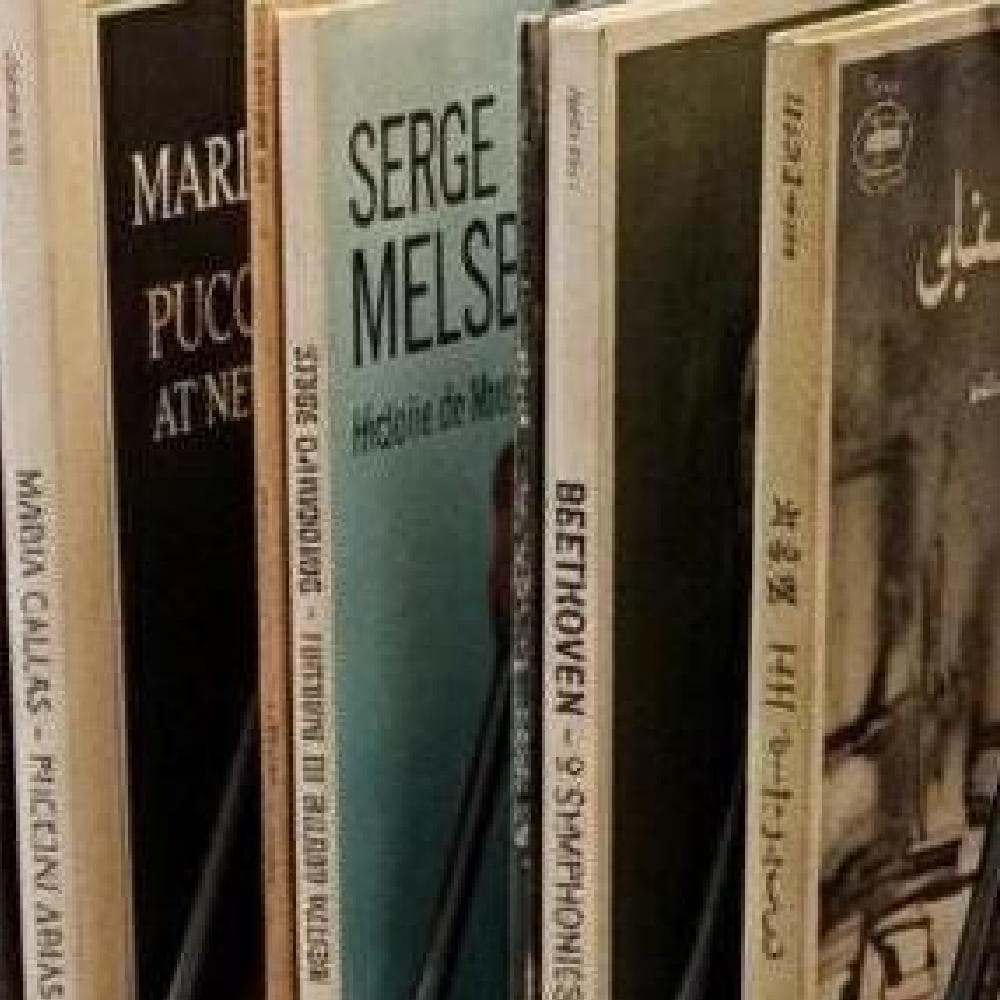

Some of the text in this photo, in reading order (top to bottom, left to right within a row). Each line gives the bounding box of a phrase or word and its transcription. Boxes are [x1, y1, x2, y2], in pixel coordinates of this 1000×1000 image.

[349, 95, 496, 228] SERGE
[153, 378, 198, 443] AT
[555, 480, 588, 717] BEETHOVEN
